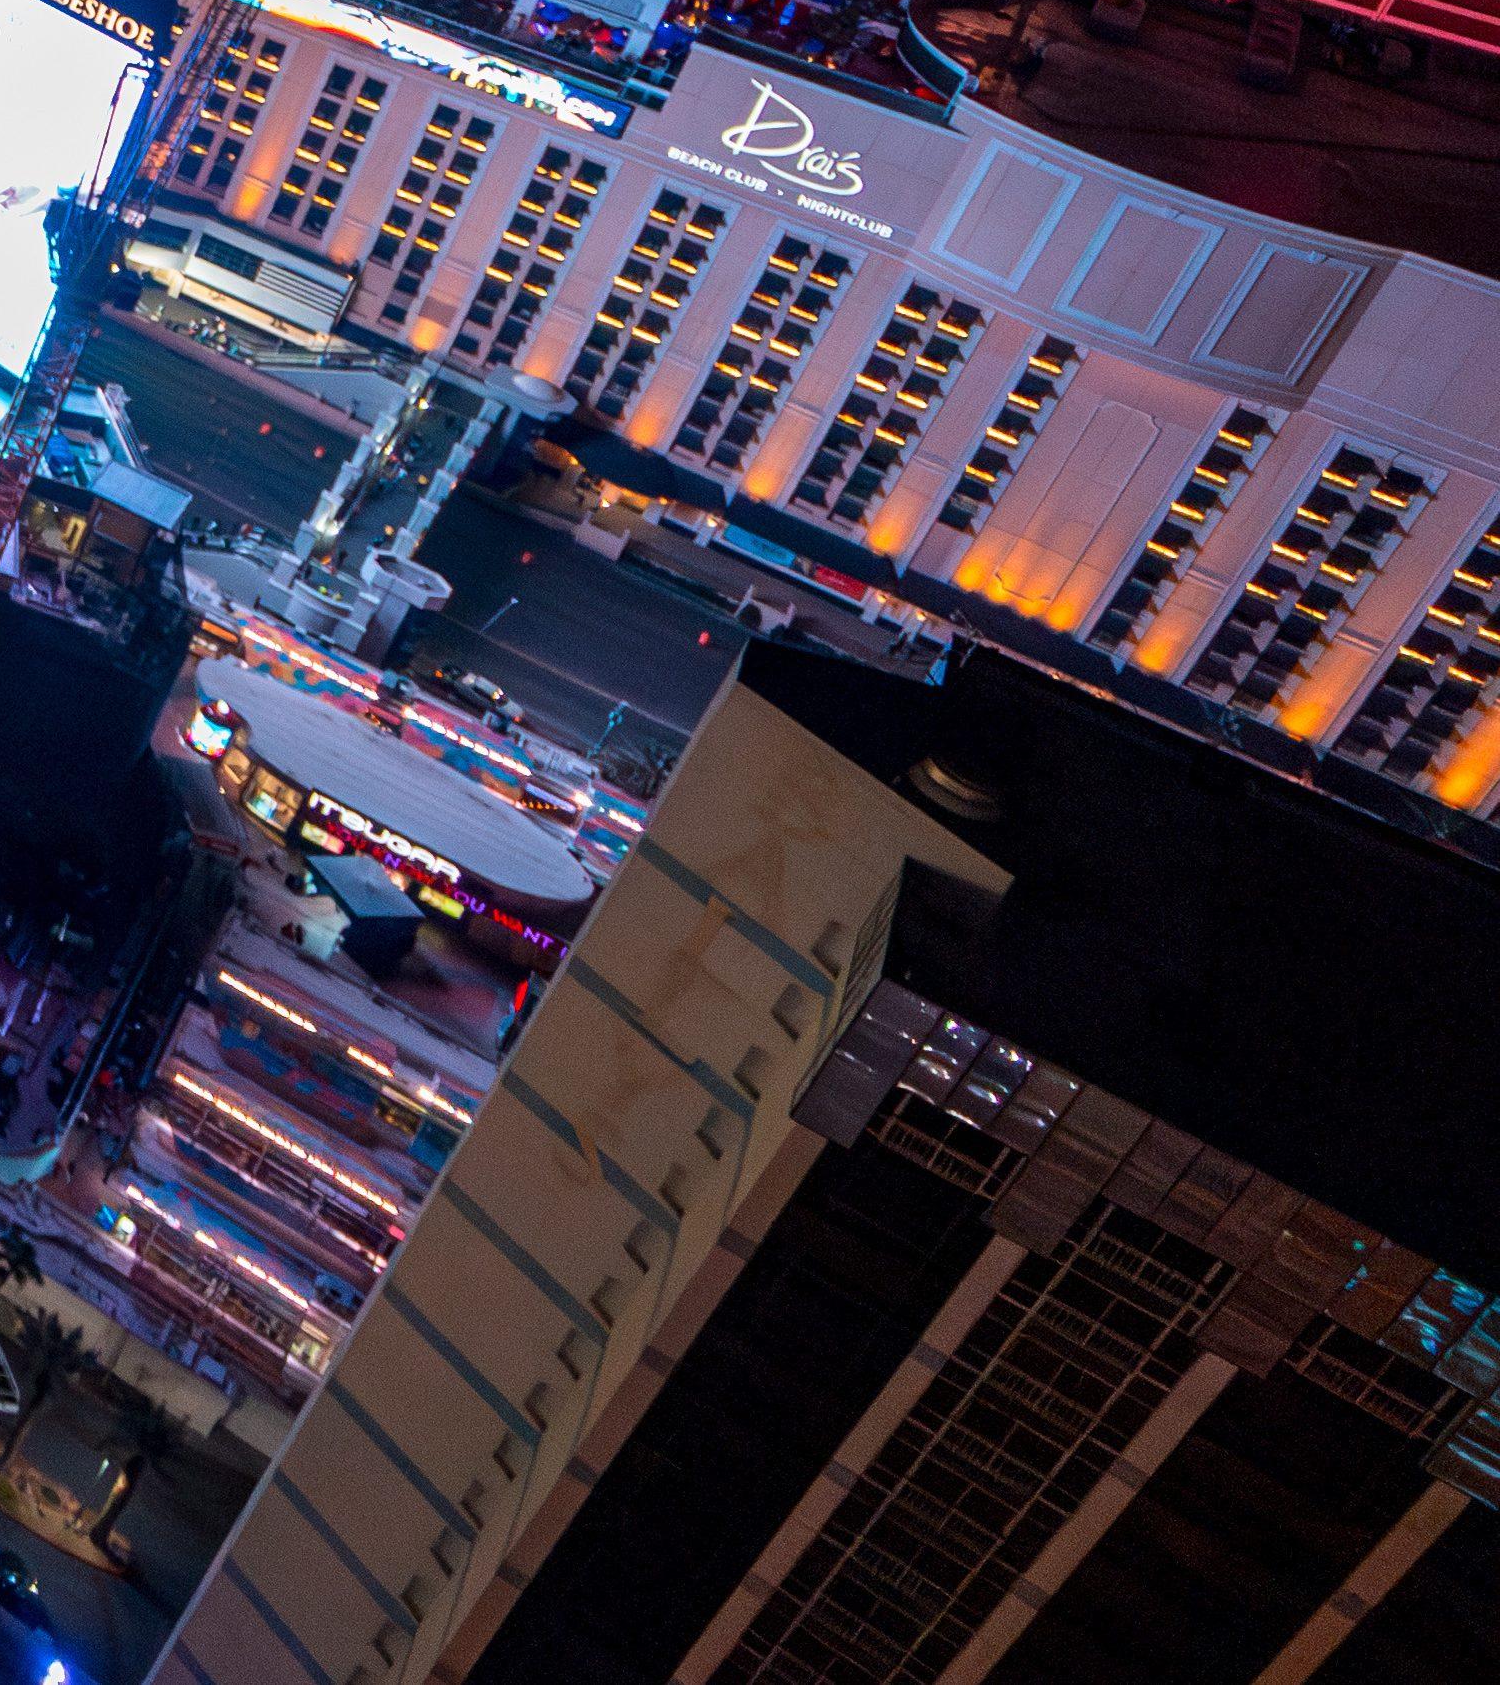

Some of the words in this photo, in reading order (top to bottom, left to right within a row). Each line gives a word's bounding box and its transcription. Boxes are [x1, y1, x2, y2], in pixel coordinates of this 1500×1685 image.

[721, 78, 863, 196] Drai's
[667, 145, 723, 176] BEACH
[723, 166, 769, 193] CLUB
[797, 194, 895, 239] NIGHTCLUB
[492, 907, 557, 950] WANT
